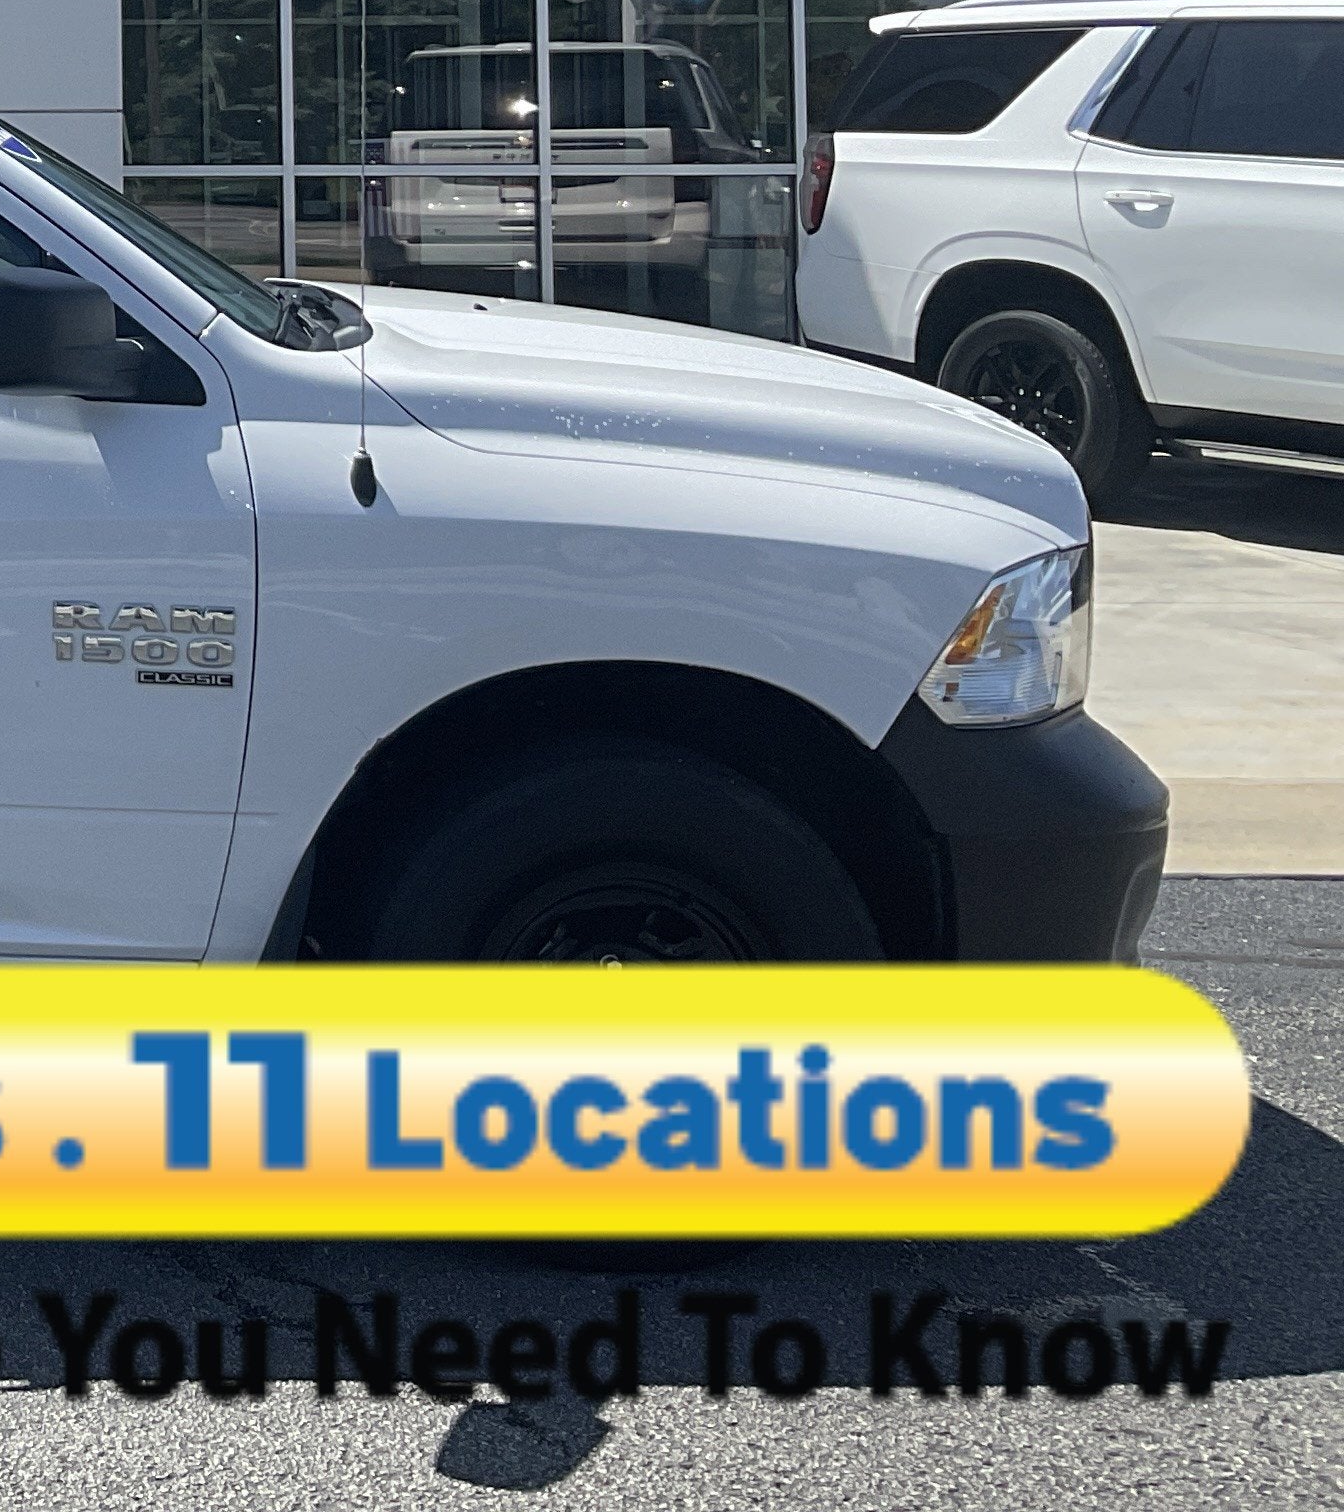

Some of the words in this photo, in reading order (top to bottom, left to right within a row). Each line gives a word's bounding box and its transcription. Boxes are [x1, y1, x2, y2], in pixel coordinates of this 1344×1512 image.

[53, 600, 236, 635] RAM
[53, 631, 236, 669] 1500
[138, 671, 233, 687] CLASSIC
